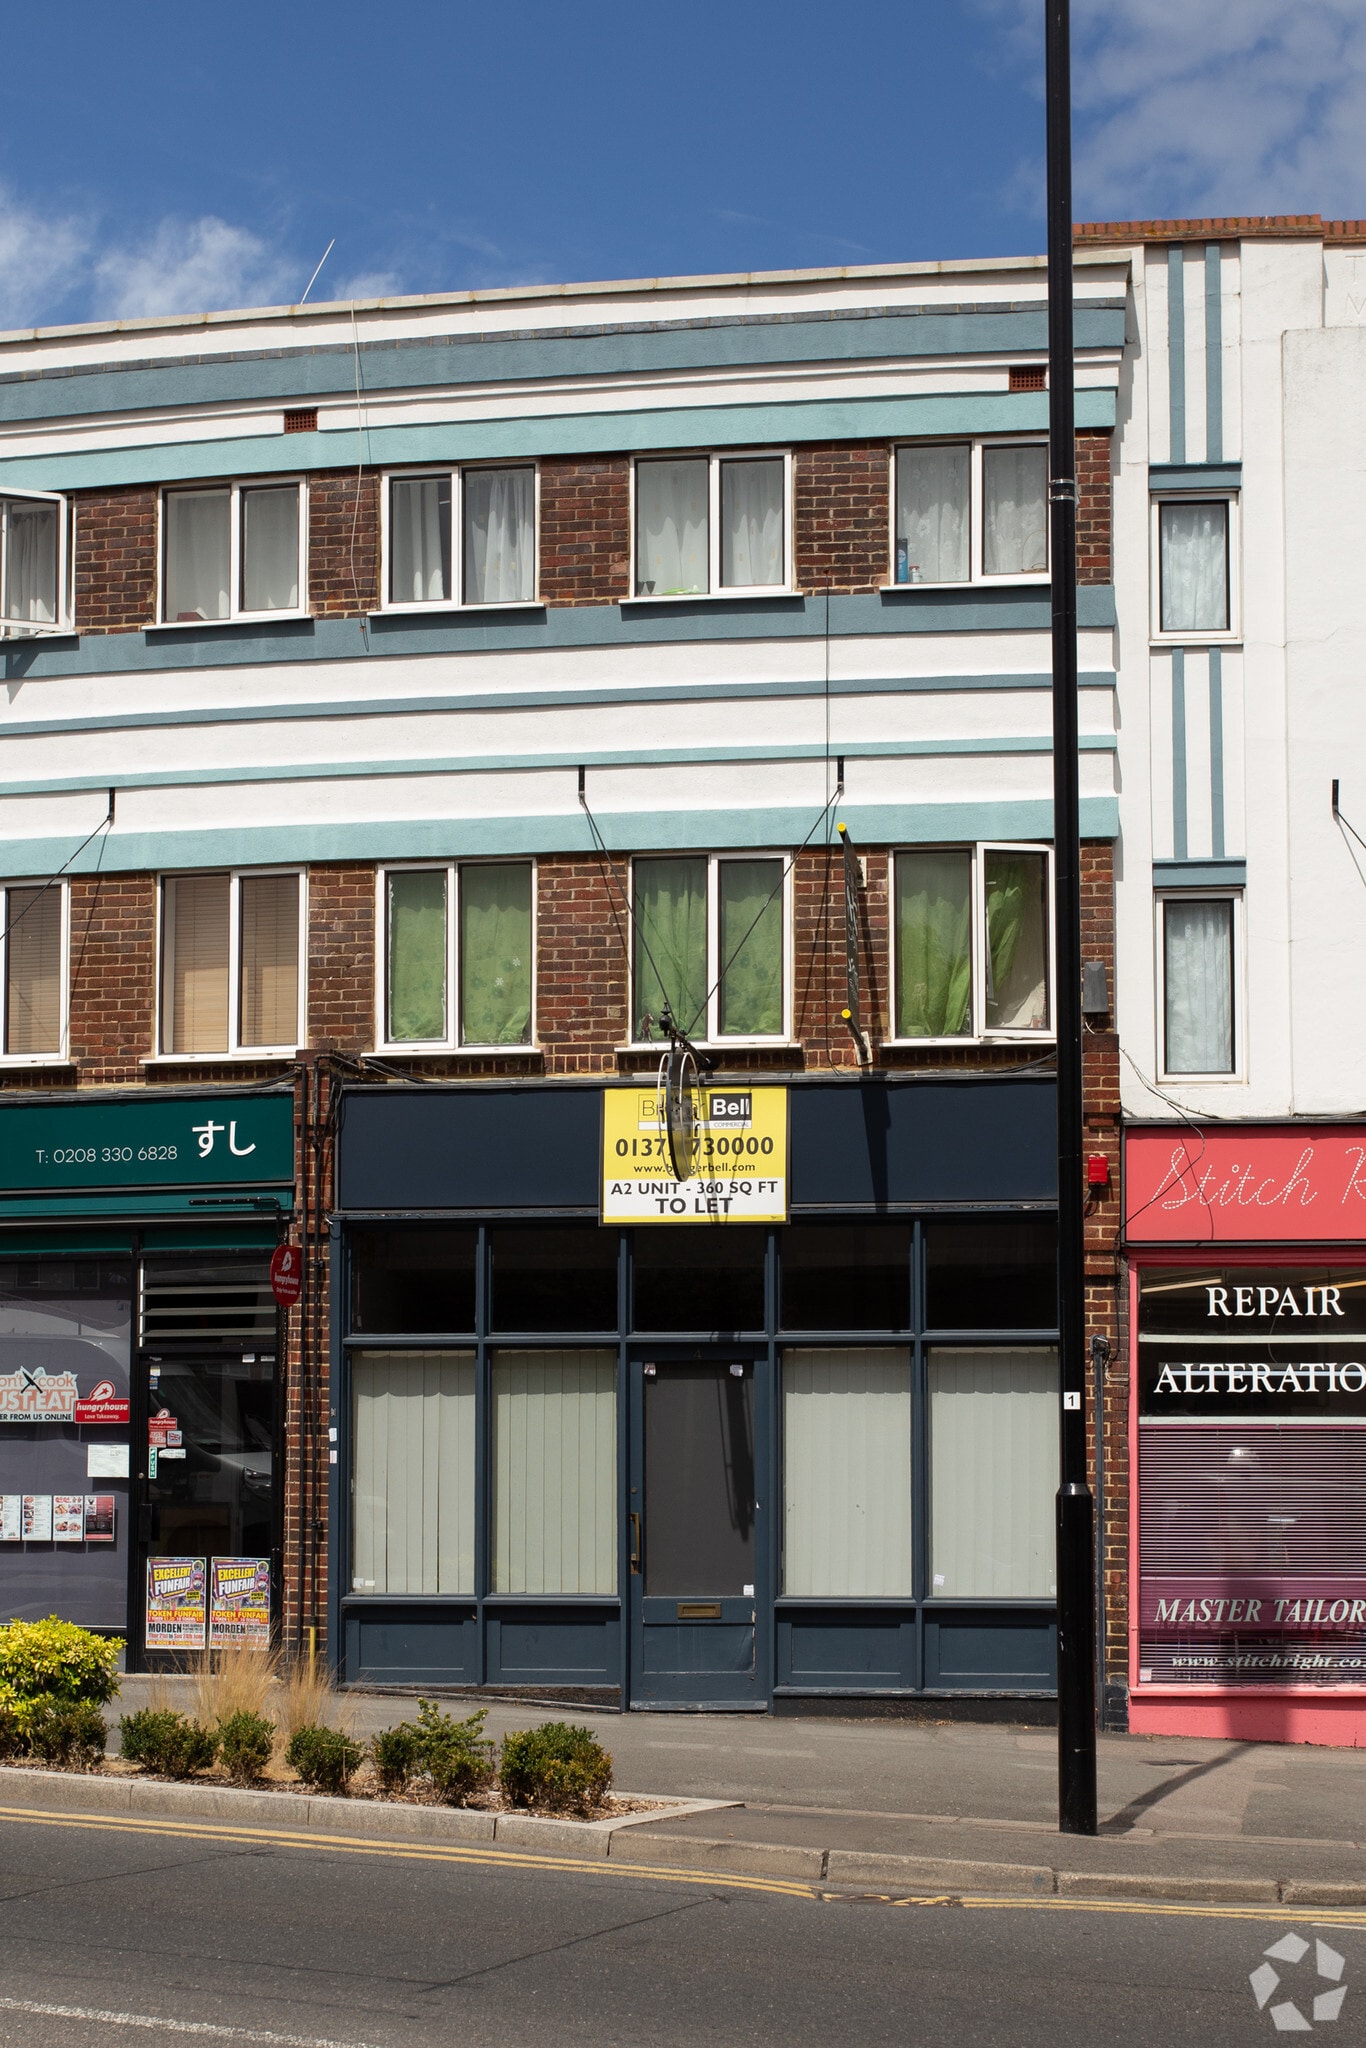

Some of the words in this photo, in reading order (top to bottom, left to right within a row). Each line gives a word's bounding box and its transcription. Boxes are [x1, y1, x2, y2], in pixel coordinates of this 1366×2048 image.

[713, 1098, 750, 1116] Bell
[192, 1120, 256, 1158] すし
[36, 1150, 49, 1164] T:
[53, 1149, 97, 1164] 0208
[101, 1147, 133, 1162] 330
[138, 1146, 178, 1160] 6828
[616, 1138, 672, 1157] 0137
[634, 1163, 755, 1175] www.bgerbell.com
[1150, 1146, 1318, 1210] Stitch
[611, 1183, 632, 1195] A2
[638, 1182, 680, 1195] UNIT
[697, 1182, 724, 1194] 360
[730, 1181, 752, 1195] SQ
[758, 1181, 778, 1193] FT
[655, 1198, 686, 1213] TO
[694, 1198, 733, 1213] LET
[1205, 1286, 1345, 1317] REPAIR
[38, 1374, 74, 1387] cook
[1153, 1362, 1366, 1393] ALTERATIO
[37, 1390, 73, 1410] EAT
[76, 1402, 129, 1413] hungryhouse
[1068, 1394, 1074, 1407] 1
[154, 1567, 191, 1581] EXCELLENT
[218, 1567, 255, 1581] EXCELLENT
[155, 1577, 190, 1595] FUNFAIR
[219, 1577, 255, 1595] FUNFAIR
[174, 1610, 203, 1618] FUNFAIR
[238, 1611, 267, 1619] FUNFAIR
[1154, 1599, 1262, 1622] MASTER
[1272, 1599, 1366, 1623] TAILOR
[148, 1623, 182, 1633] MORDEN
[212, 1623, 245, 1634] MORDEN
